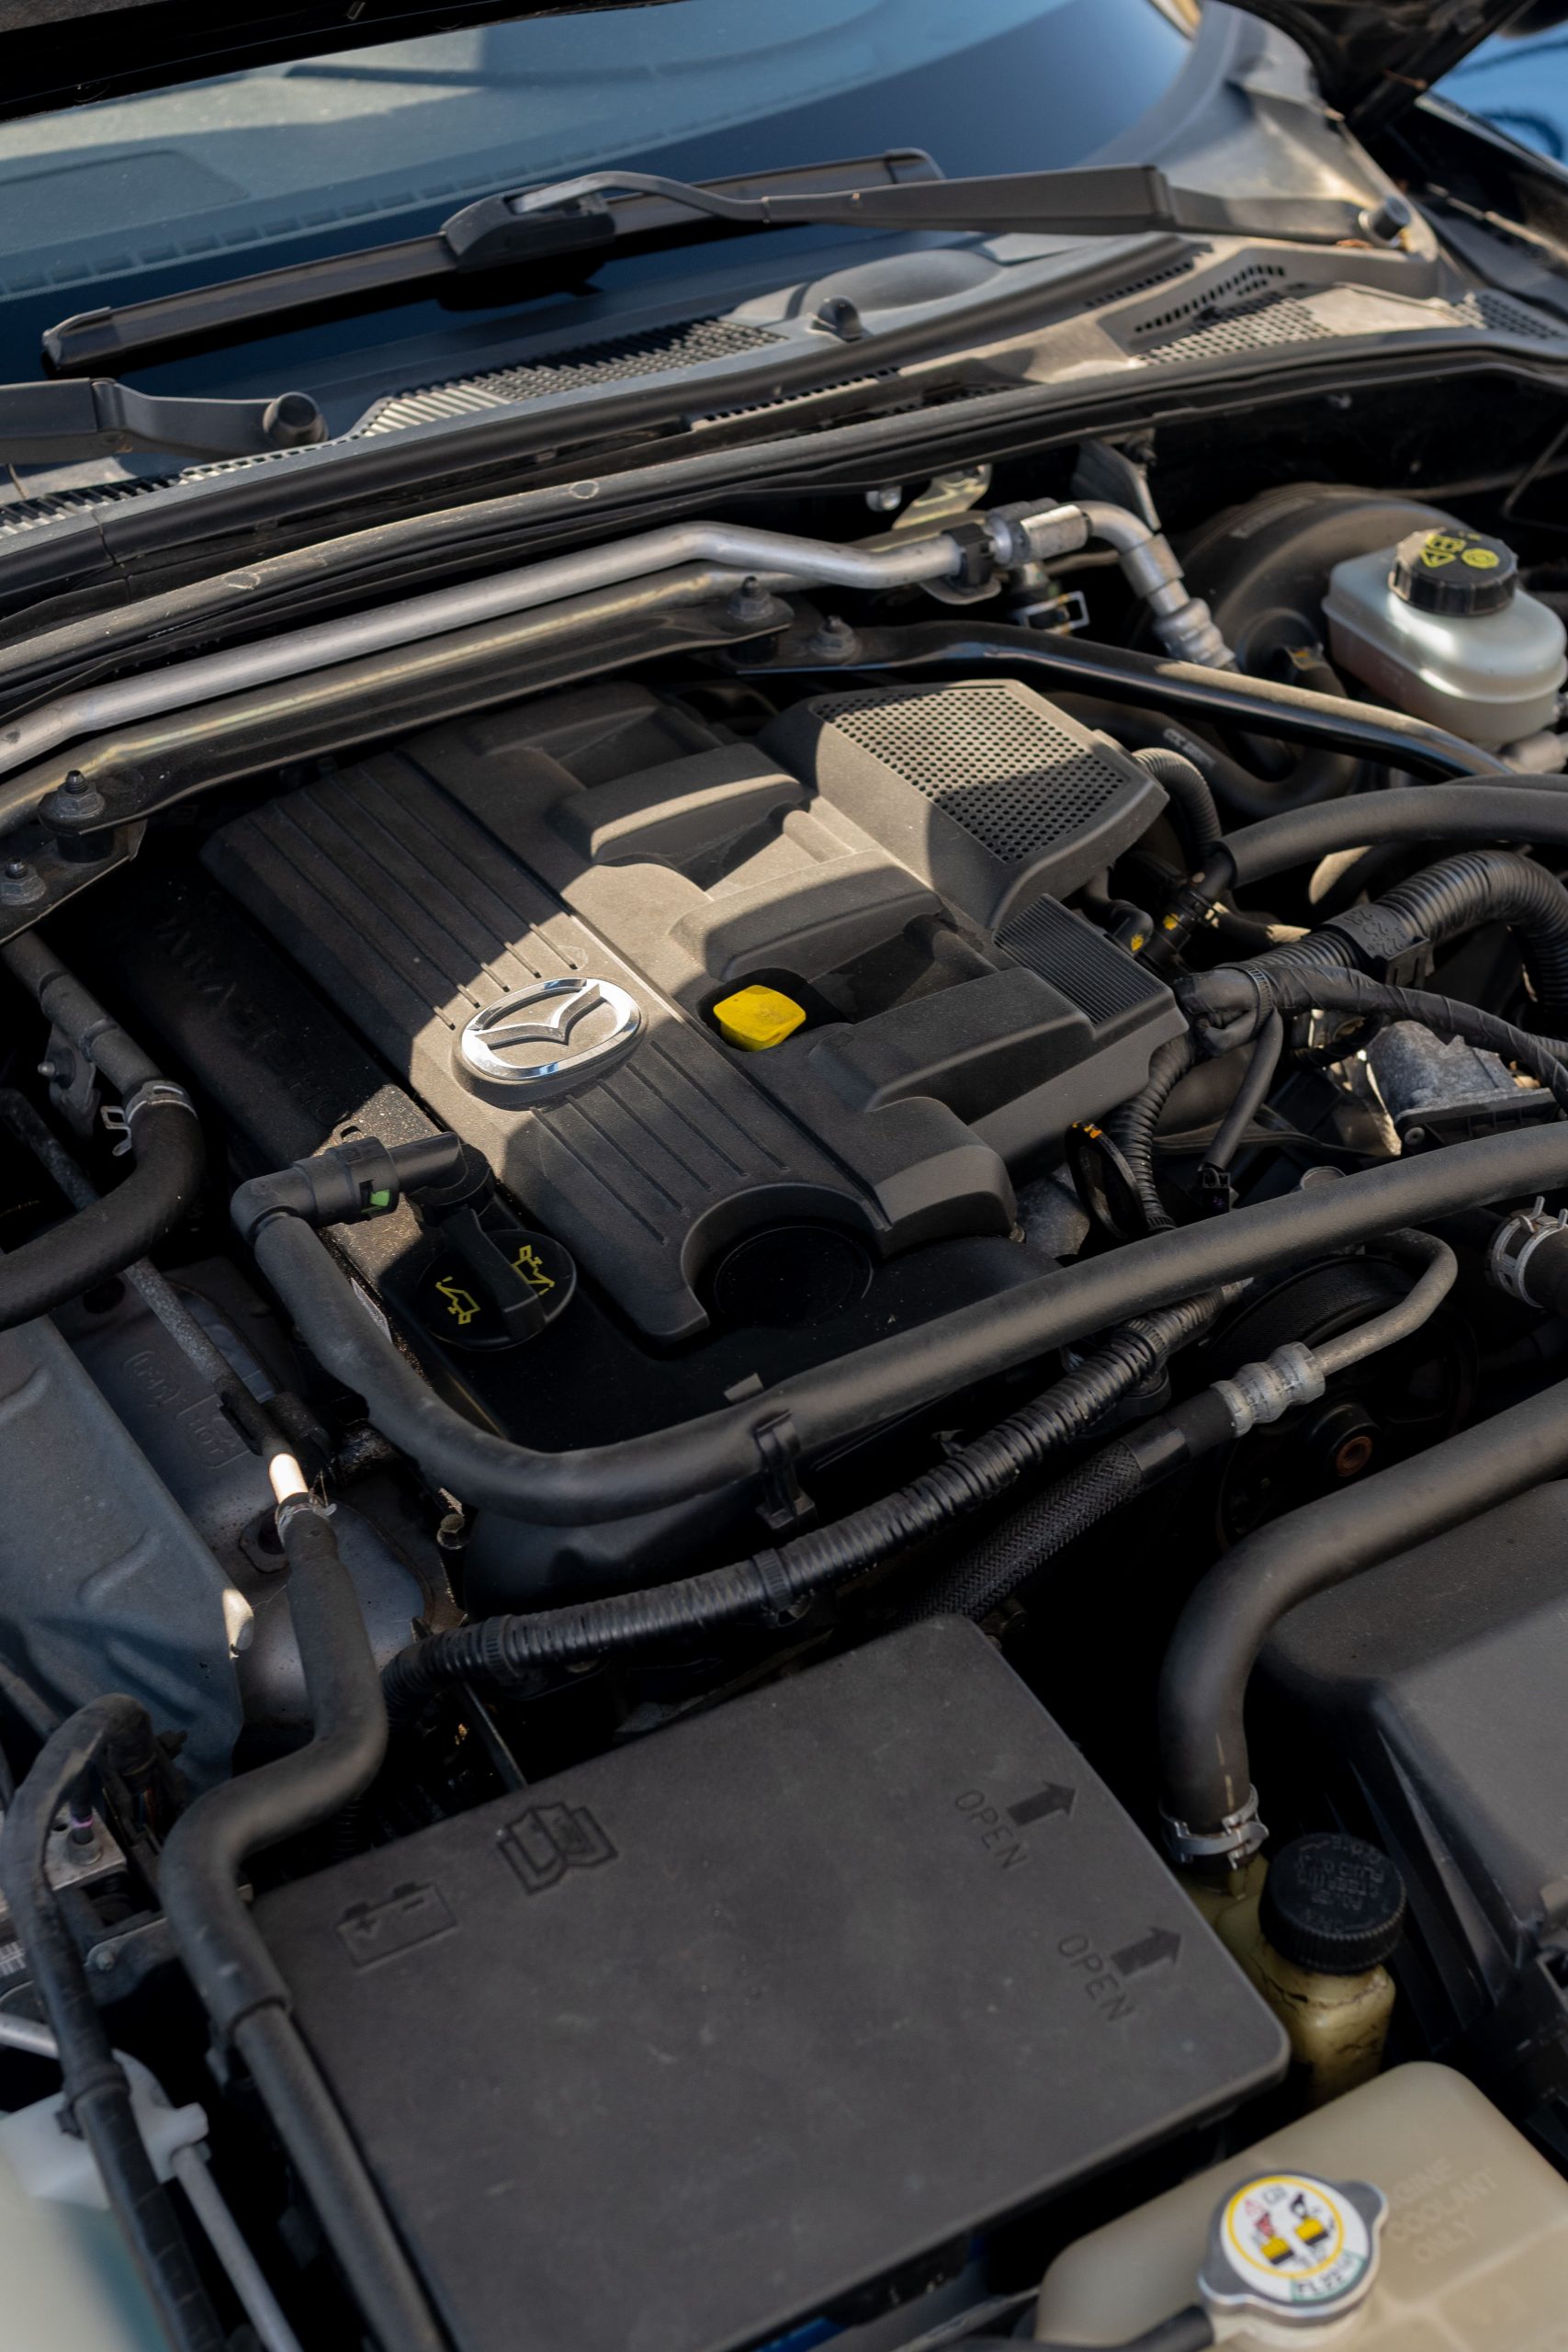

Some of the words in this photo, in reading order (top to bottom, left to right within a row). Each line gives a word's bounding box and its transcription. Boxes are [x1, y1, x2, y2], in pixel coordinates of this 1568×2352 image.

[955, 1790, 1028, 1869] OPEN
[1058, 1934, 1134, 2020] OPEN
[1387, 2167, 1499, 2244] COOLANT
[1413, 2214, 1476, 2264] ONLY
